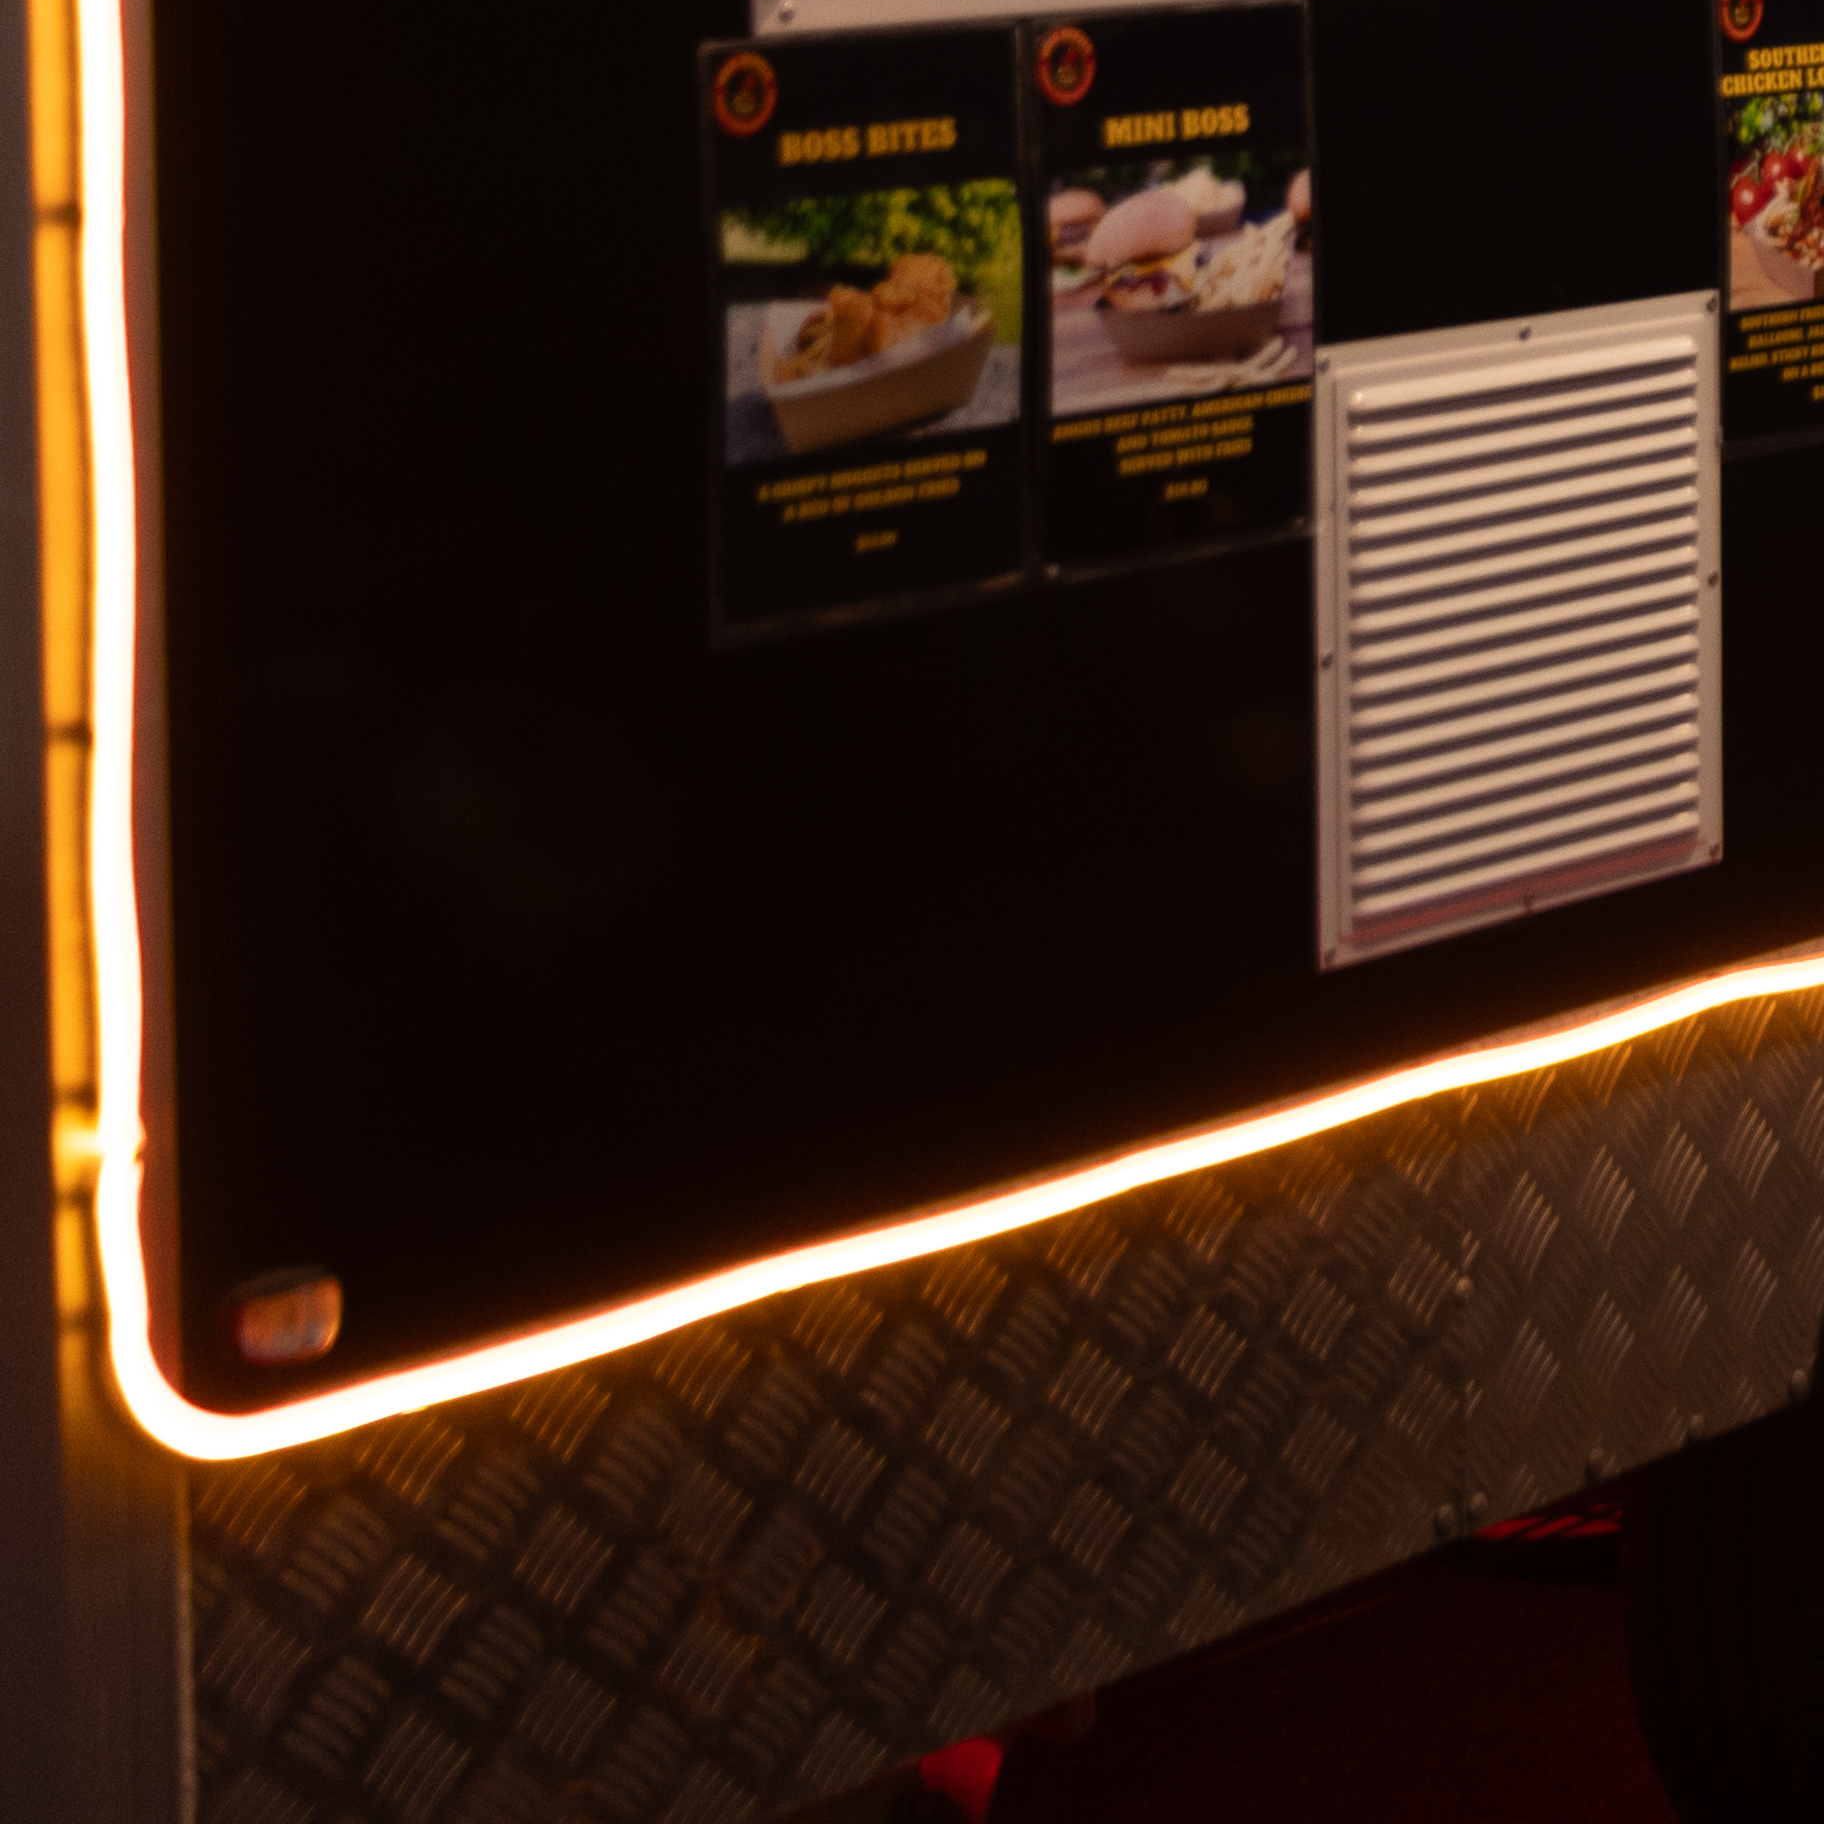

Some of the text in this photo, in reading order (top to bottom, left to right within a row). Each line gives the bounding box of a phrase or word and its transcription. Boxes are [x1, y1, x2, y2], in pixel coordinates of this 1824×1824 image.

[1721, 69, 1803, 100] CHICKEN
[779, 116, 958, 168] BOSS BITES
[1103, 103, 1250, 150] MINI BOSS
[1740, 309, 1799, 332] SOUTHERN
[1191, 393, 1264, 419] AMERICAN
